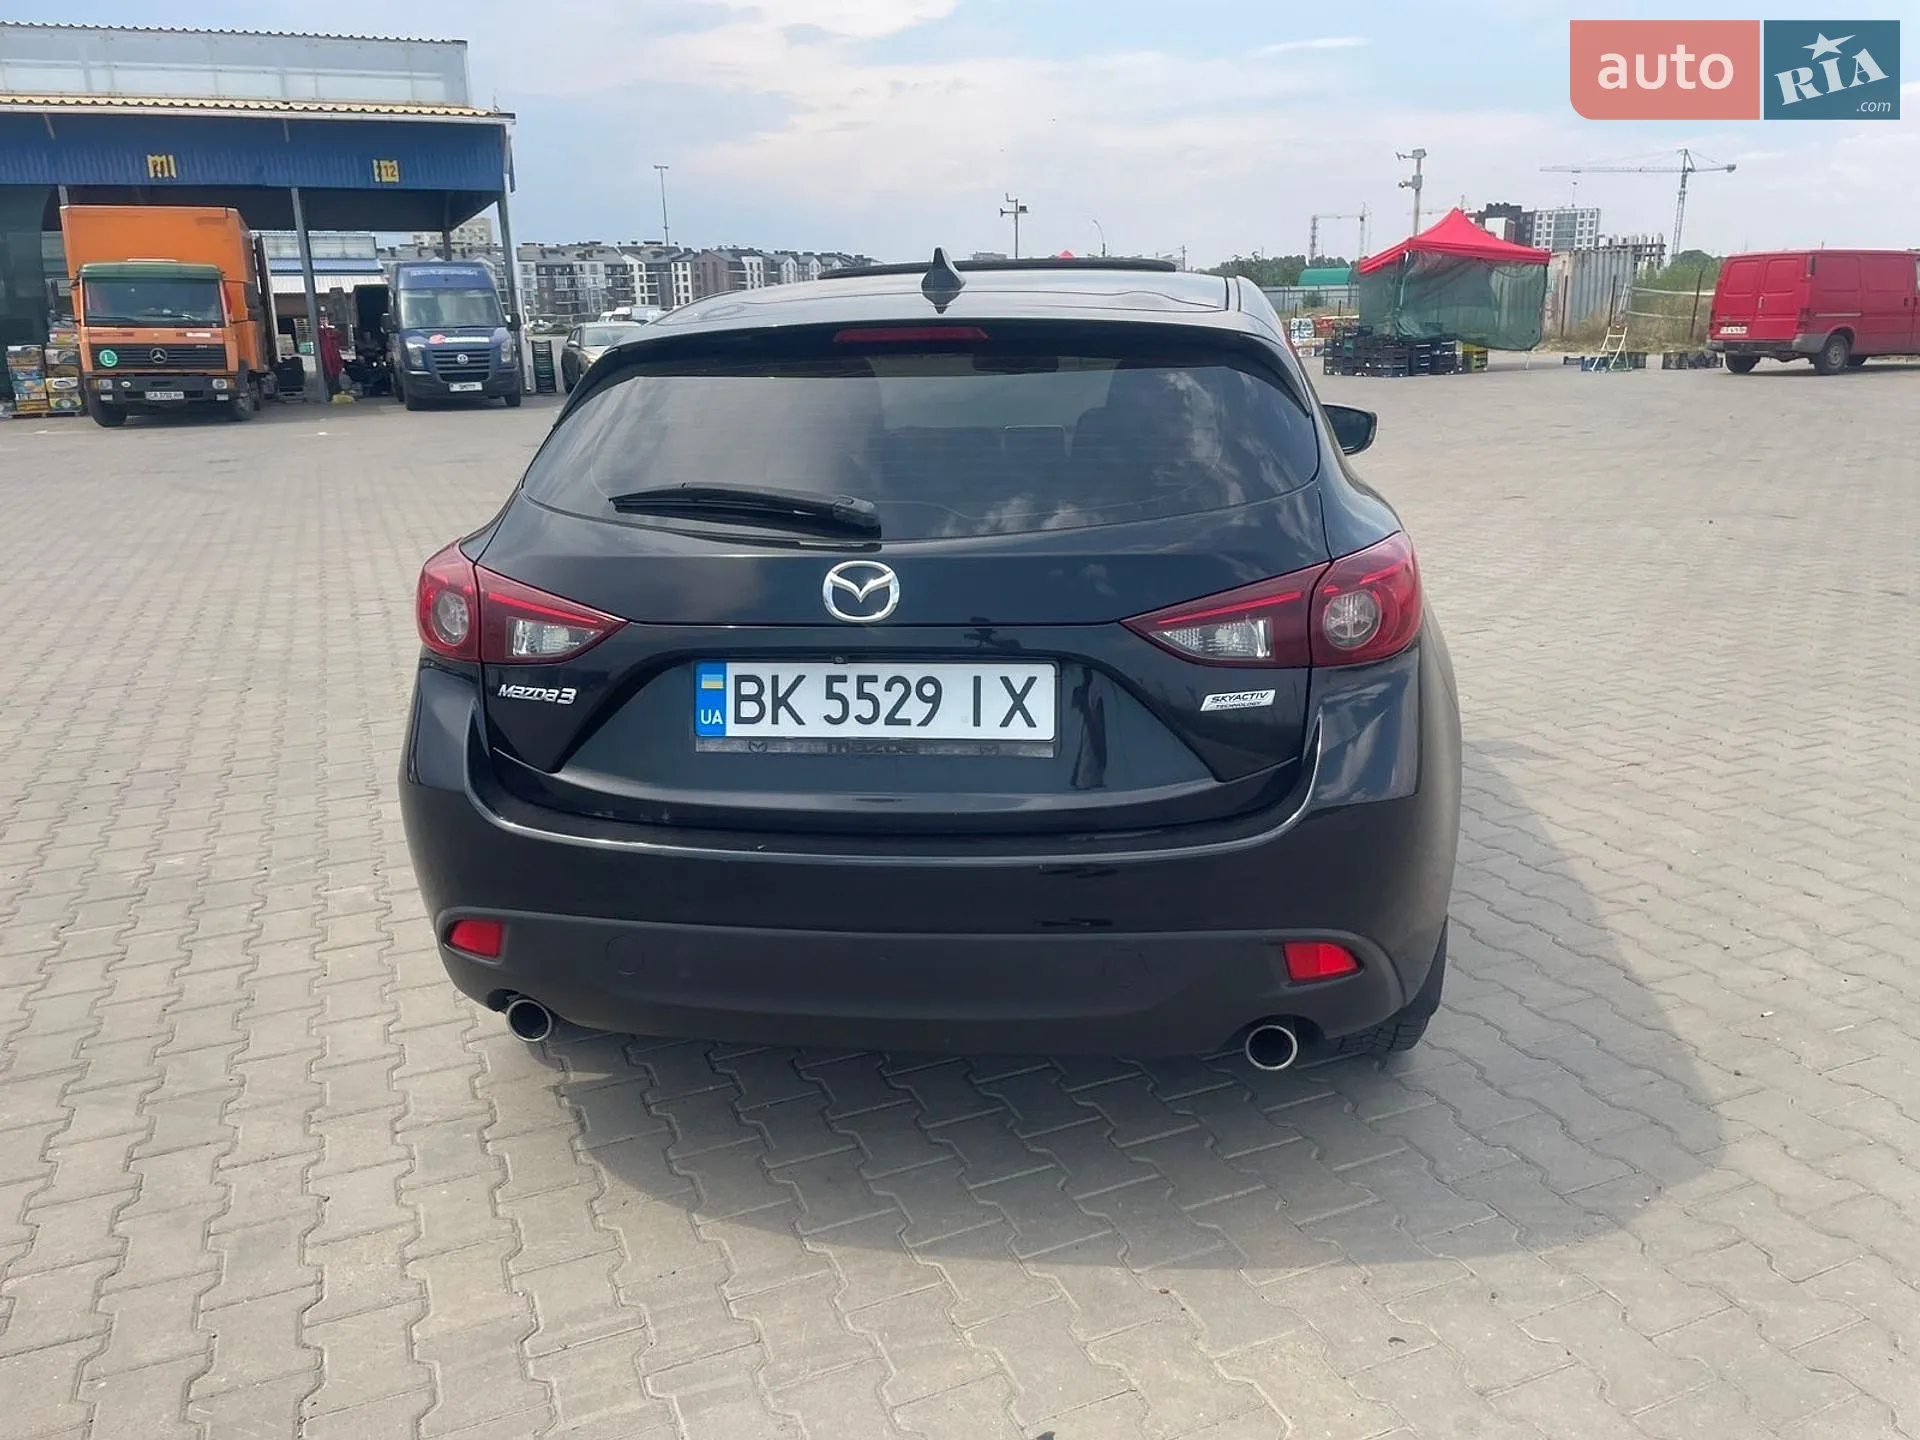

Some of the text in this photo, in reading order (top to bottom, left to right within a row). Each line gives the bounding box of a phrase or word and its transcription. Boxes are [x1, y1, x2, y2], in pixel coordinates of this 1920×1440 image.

[733, 674, 807, 726] BK
[823, 674, 944, 727] 5529
[1211, 691, 1269, 702] SKYACTIV
[700, 710, 724, 725] UA
